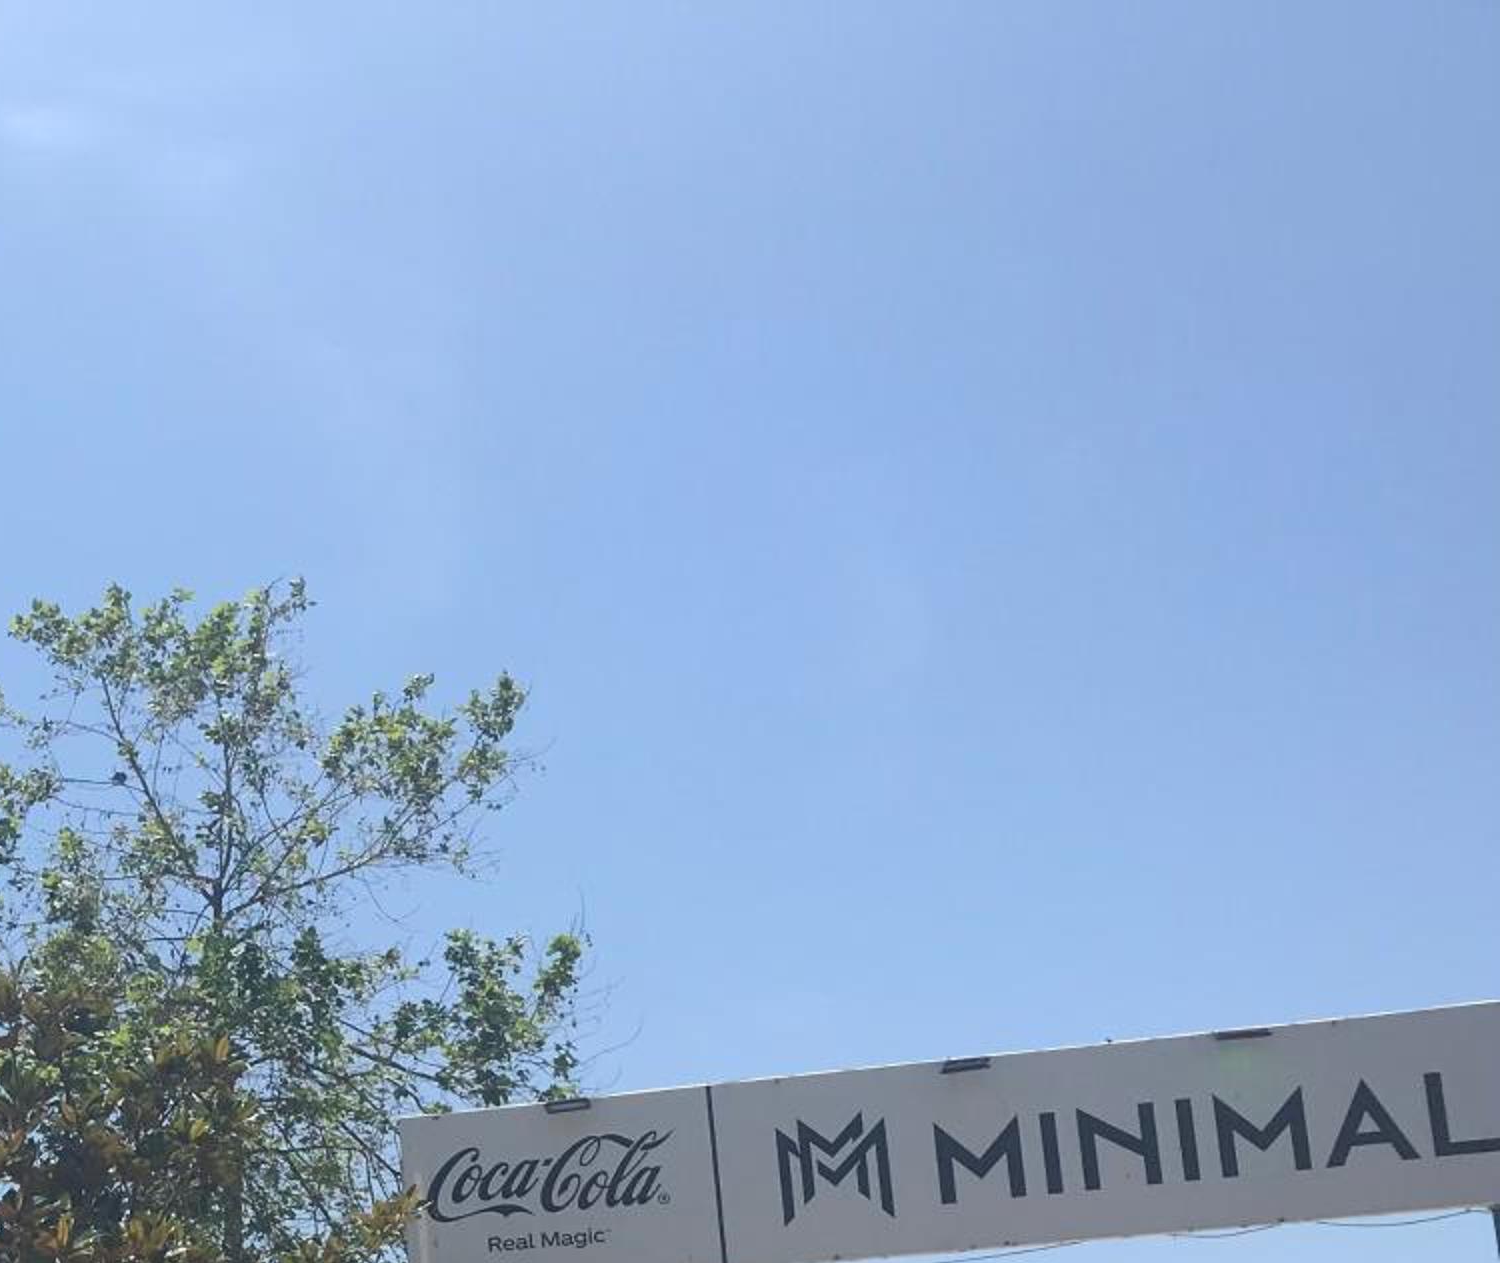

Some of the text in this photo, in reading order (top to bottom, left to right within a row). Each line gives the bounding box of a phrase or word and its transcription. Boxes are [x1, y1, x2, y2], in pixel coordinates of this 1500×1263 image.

[427, 1130, 674, 1223] Coca-Cola
[932, 1071, 1500, 1205] MINIMAL
[487, 1228, 607, 1253] Real Magic
